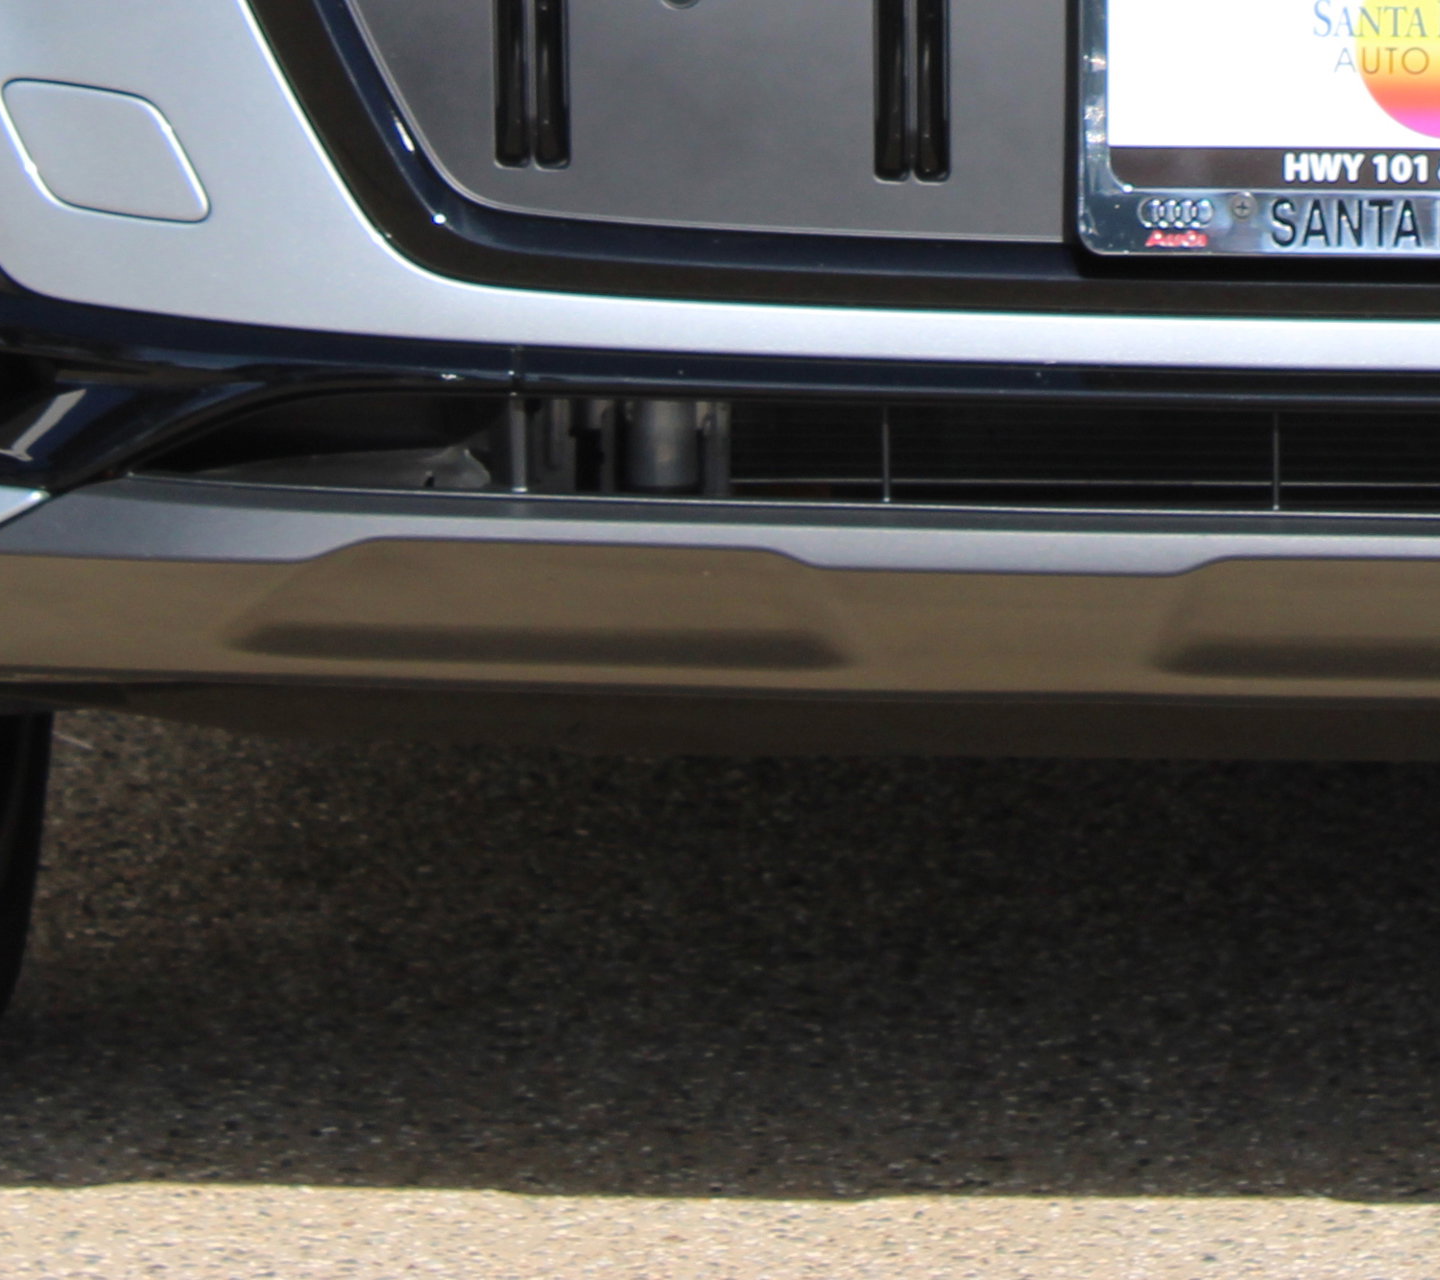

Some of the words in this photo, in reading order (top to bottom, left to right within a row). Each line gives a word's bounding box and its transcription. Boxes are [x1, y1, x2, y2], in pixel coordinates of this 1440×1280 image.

[1334, 46, 1430, 75] AUTO
[1284, 153, 1364, 182] HWY
[1372, 154, 1428, 183] 101
[1271, 198, 1422, 248] SANTA
